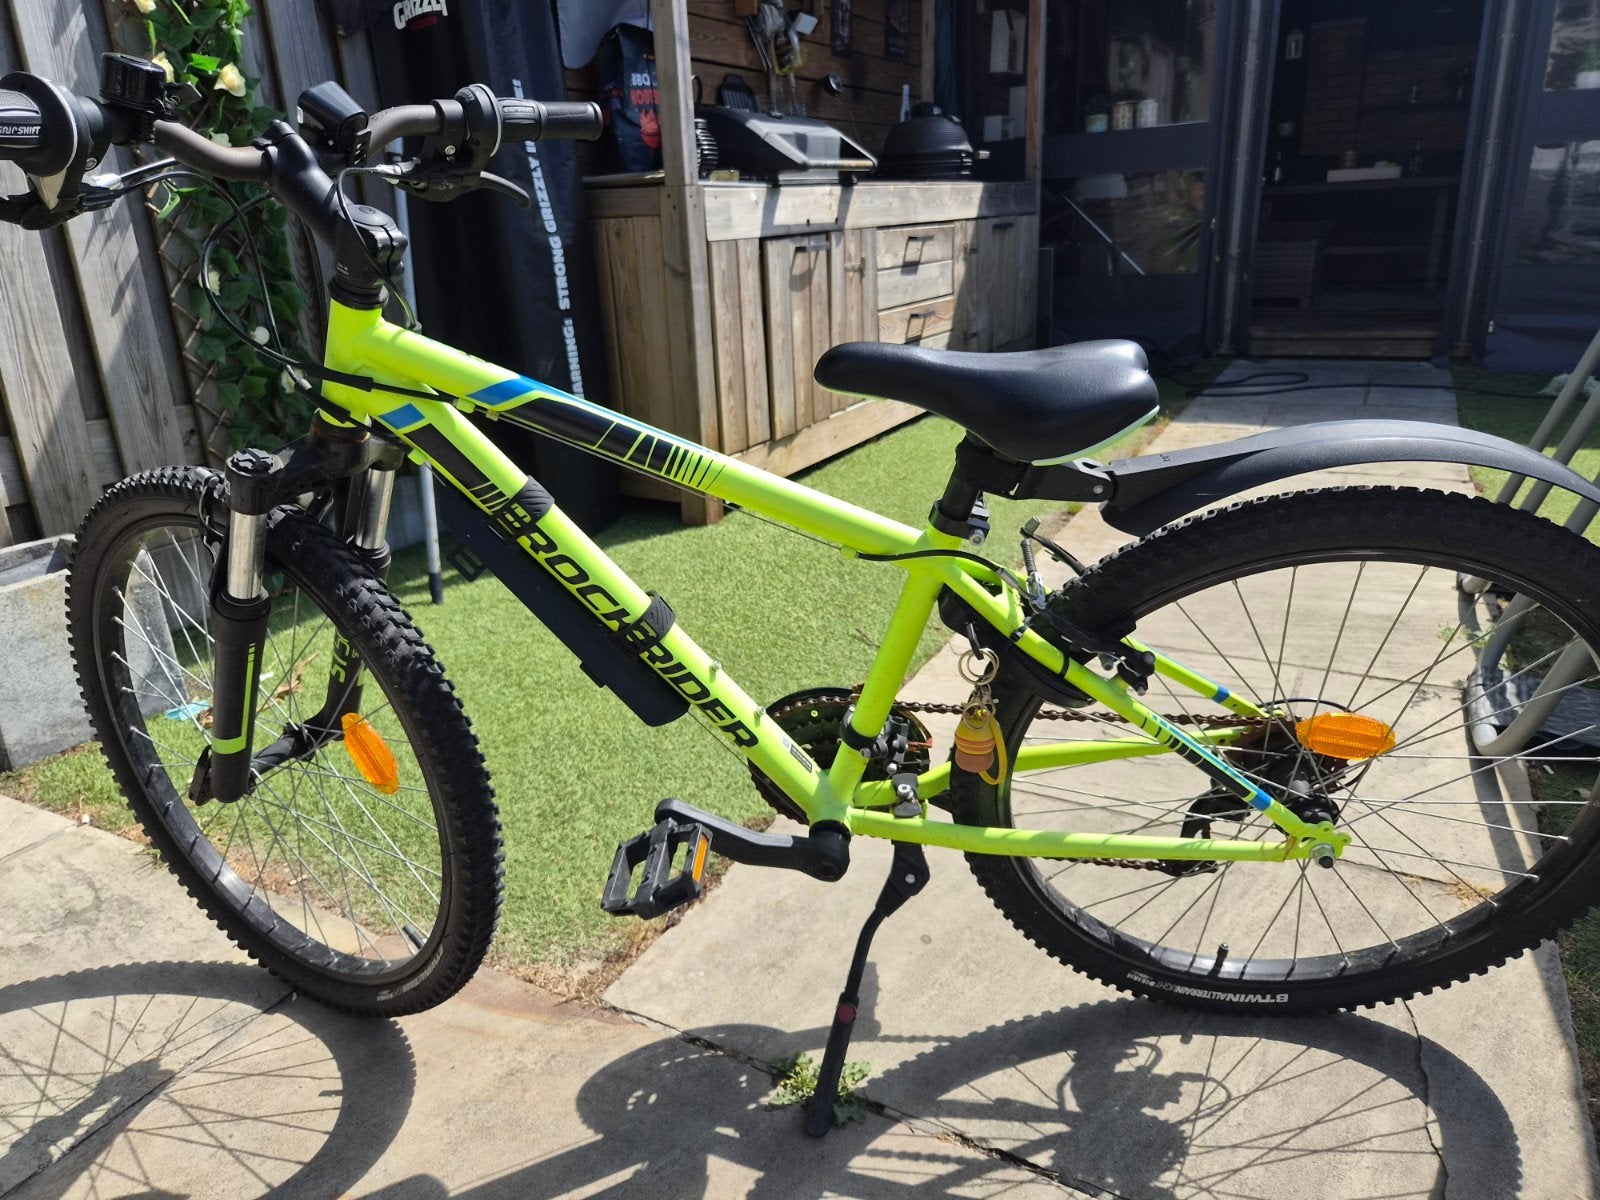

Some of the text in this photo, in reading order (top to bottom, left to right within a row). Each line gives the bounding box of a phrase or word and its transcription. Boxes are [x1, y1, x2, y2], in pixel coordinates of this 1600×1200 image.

[631, 72, 651, 86] BBQ
[17, 126, 41, 135] SHIFT
[527, 155, 557, 234] GRIZZLY
[548, 235, 571, 311] STRONG
[1225, 993, 1289, 1003] BTWIN
